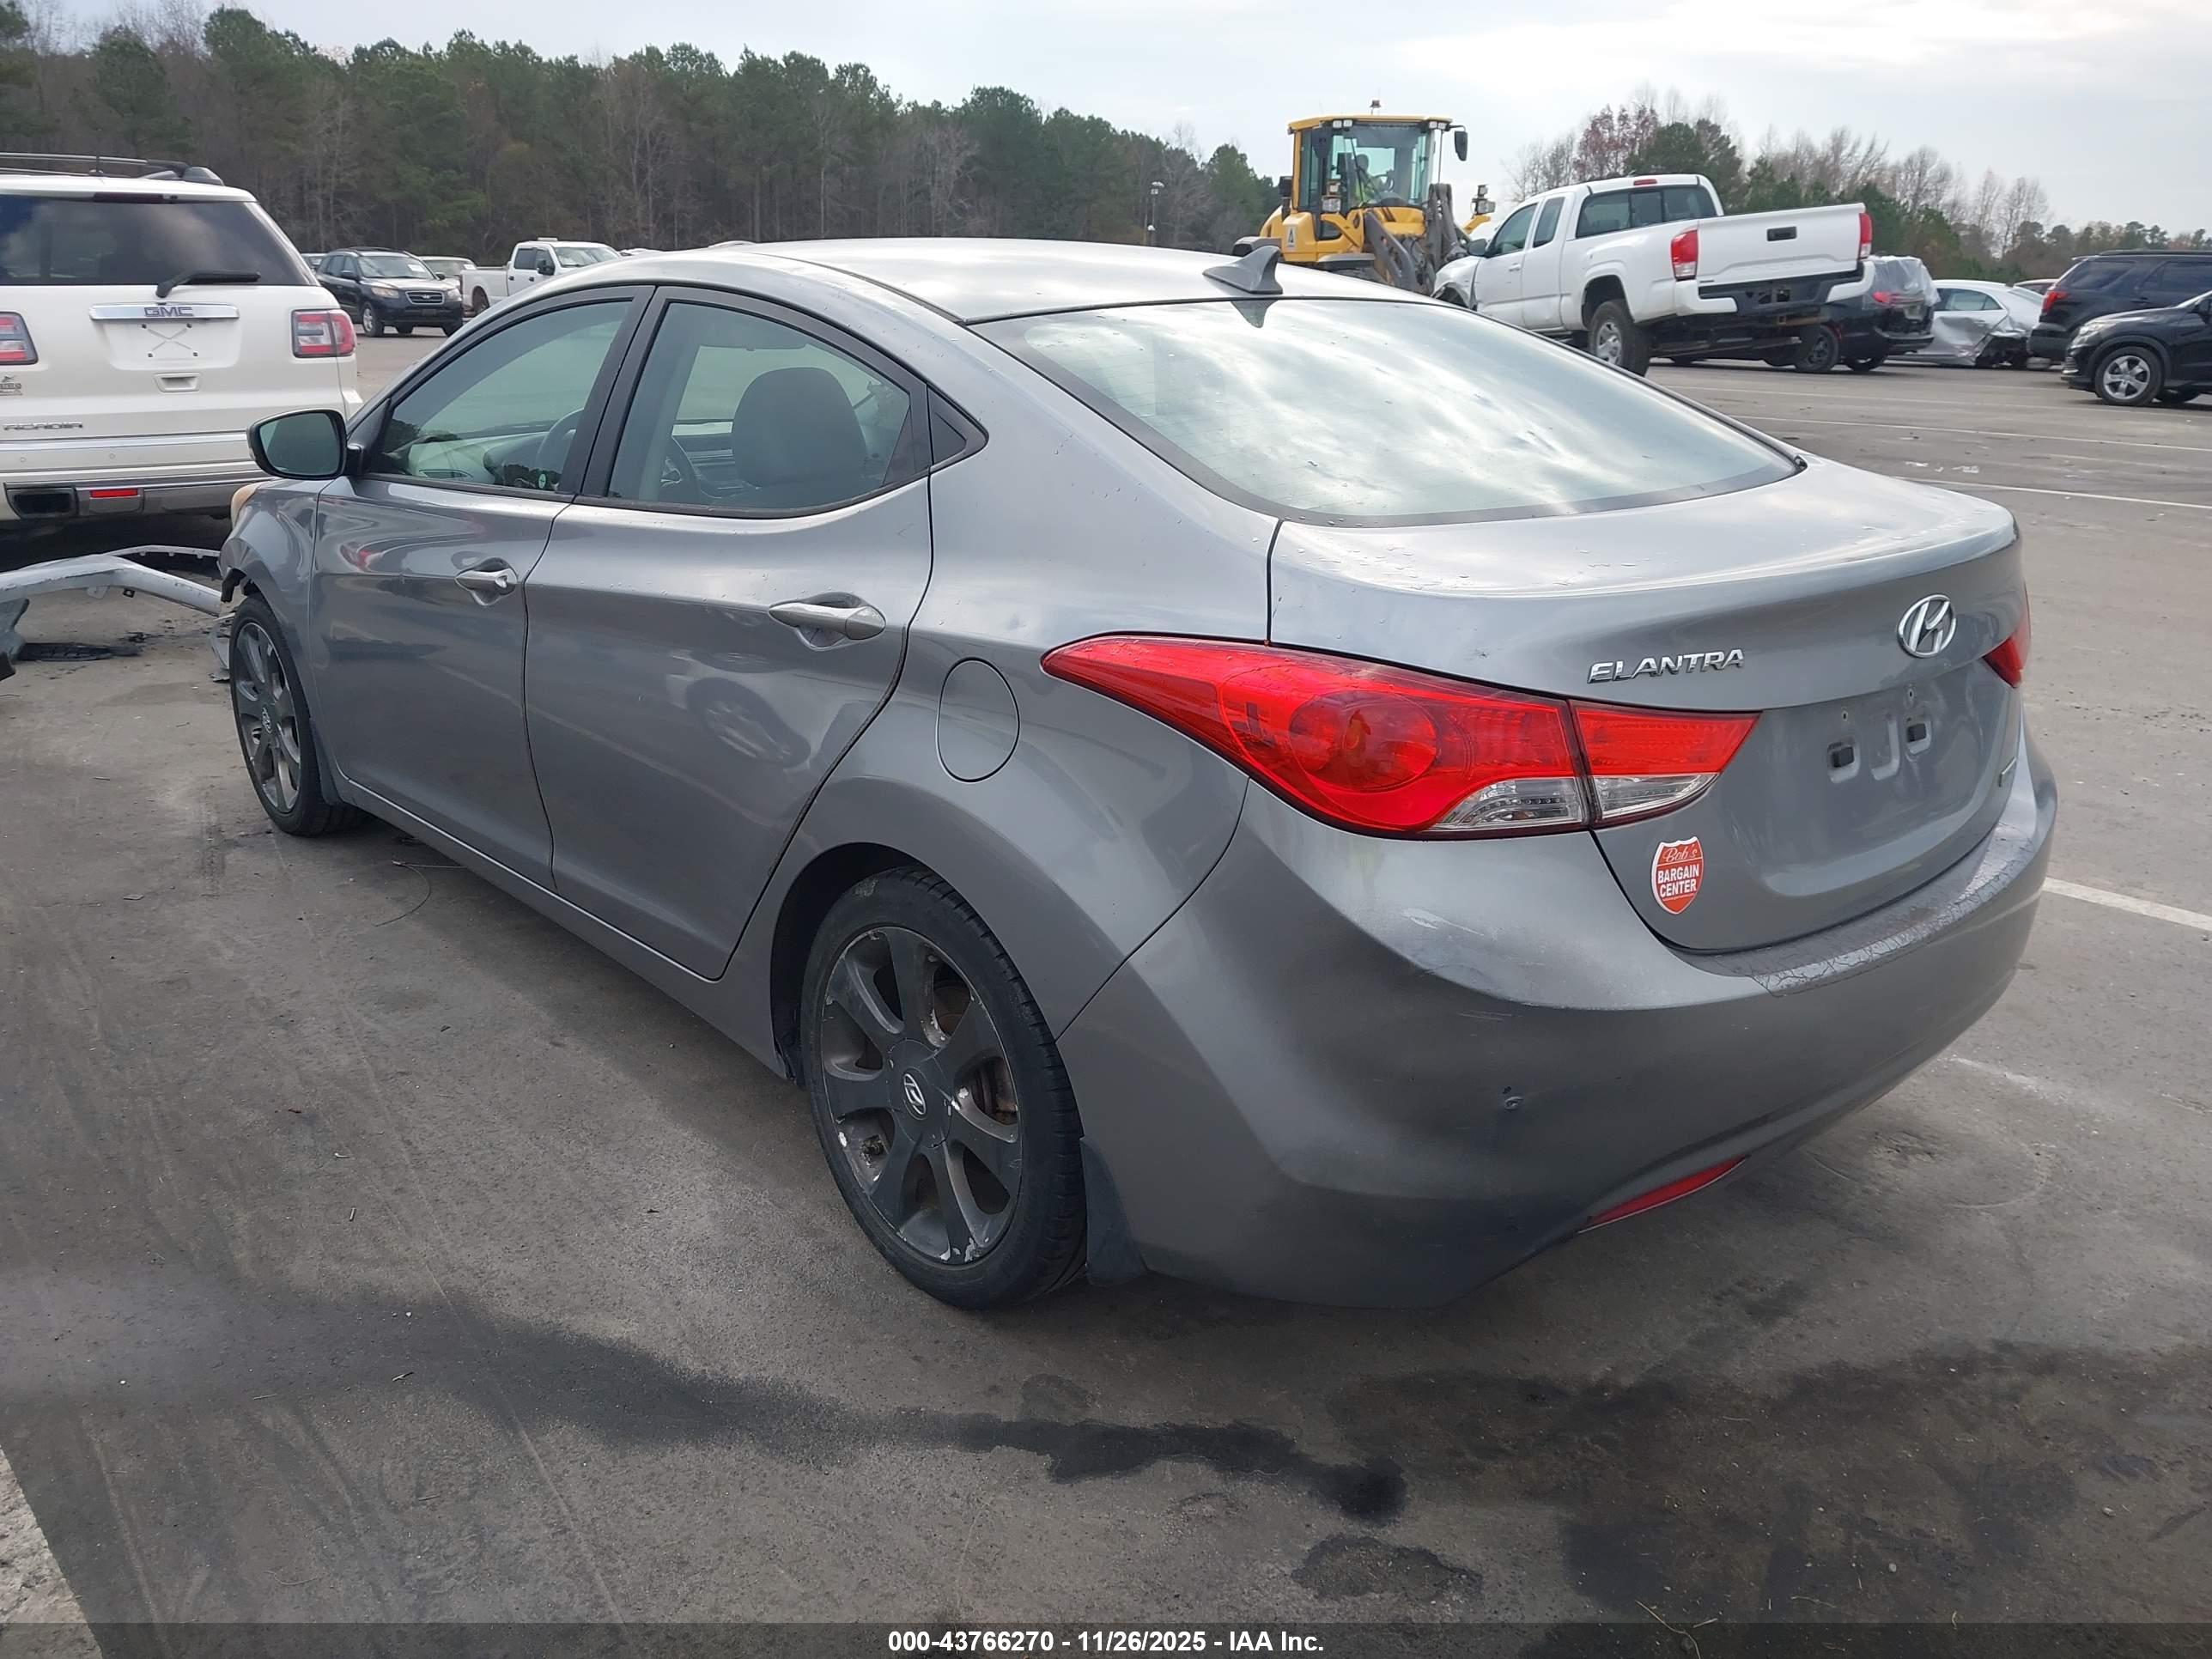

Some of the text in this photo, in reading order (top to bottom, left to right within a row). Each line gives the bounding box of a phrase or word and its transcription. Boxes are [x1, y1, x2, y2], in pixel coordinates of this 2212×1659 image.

[143, 307, 194, 318] GMC
[1587, 648, 1744, 684] ELANTRA
[1662, 844, 1698, 862] Bob's
[1657, 864, 1699, 884] BARGAIN
[1659, 878, 1697, 897] CENTER
